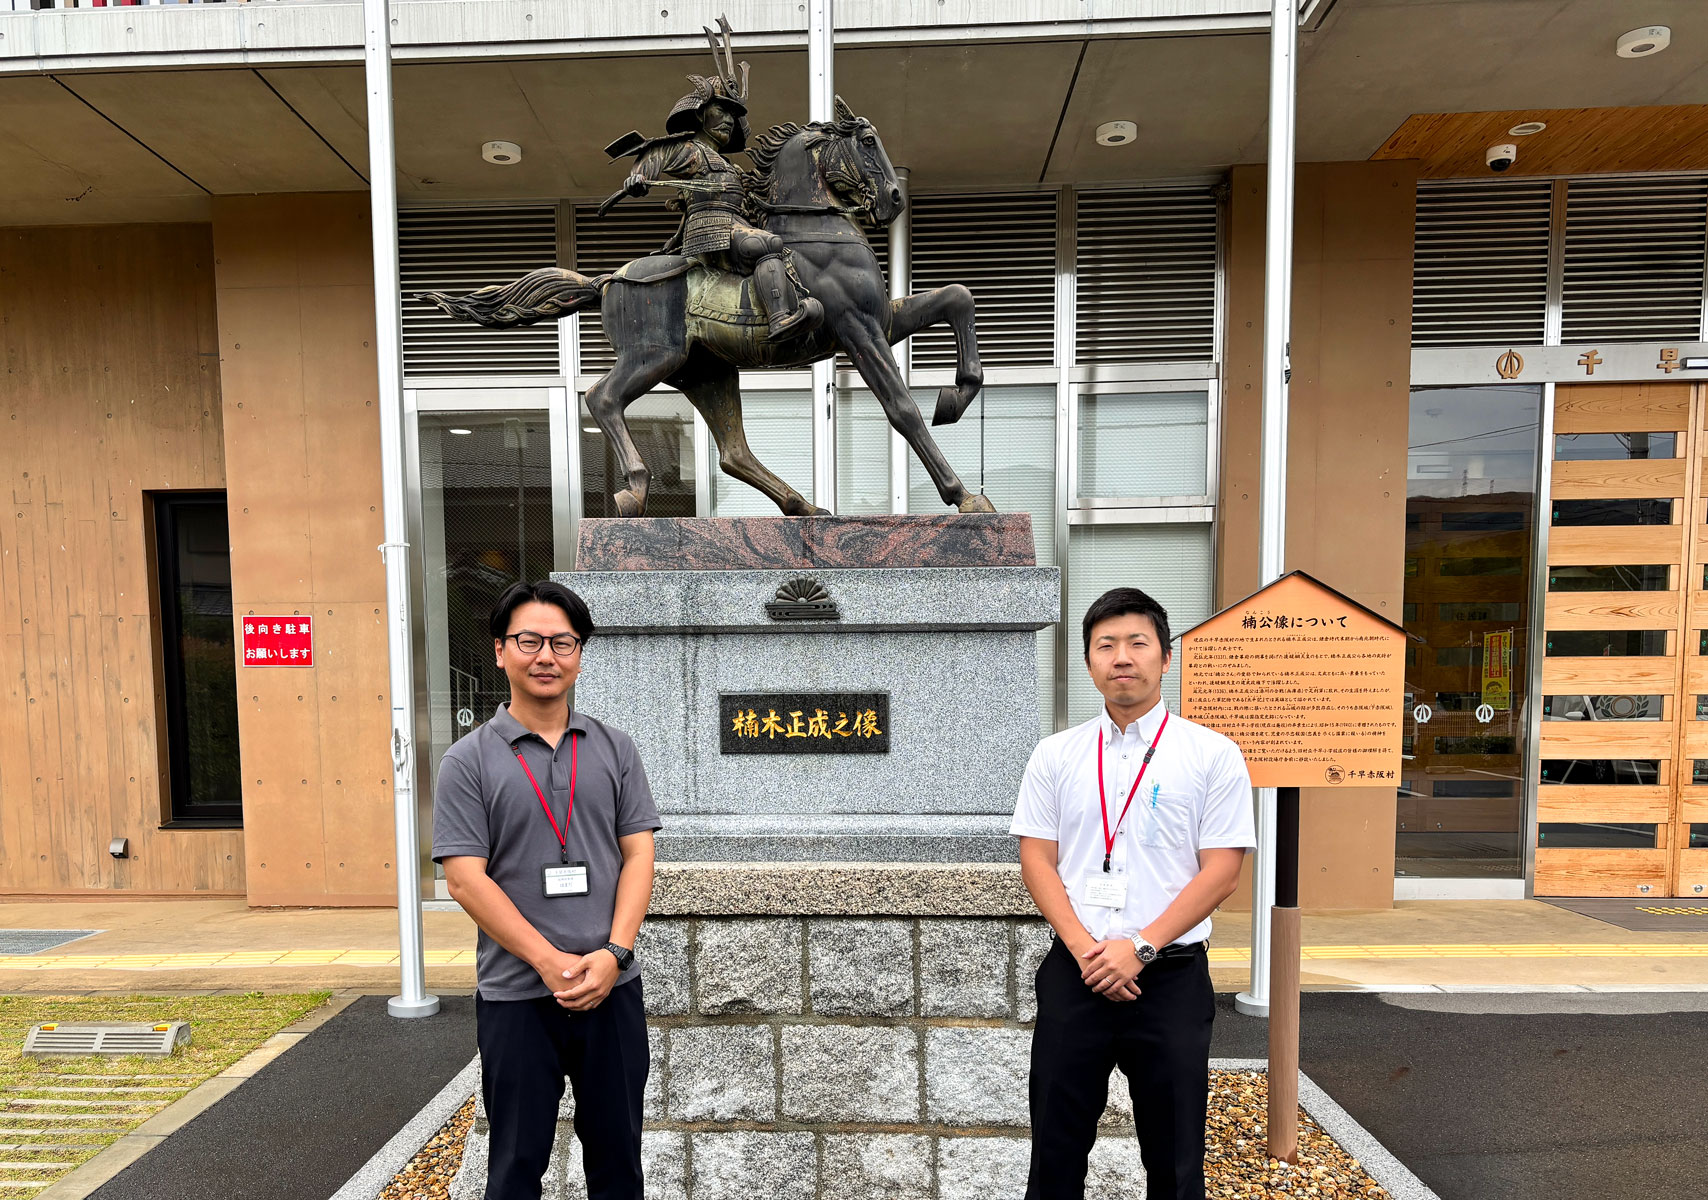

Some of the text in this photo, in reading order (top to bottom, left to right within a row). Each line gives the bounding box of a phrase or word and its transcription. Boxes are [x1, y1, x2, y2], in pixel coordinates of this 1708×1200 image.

[1241, 615, 1348, 630] 楠公像について
[244, 623, 311, 635] 後向き駐車
[245, 647, 311, 659] お願いします
[731, 708, 883, 740] 楠木正成之像
[1348, 770, 1395, 779] 千早赤阪村
